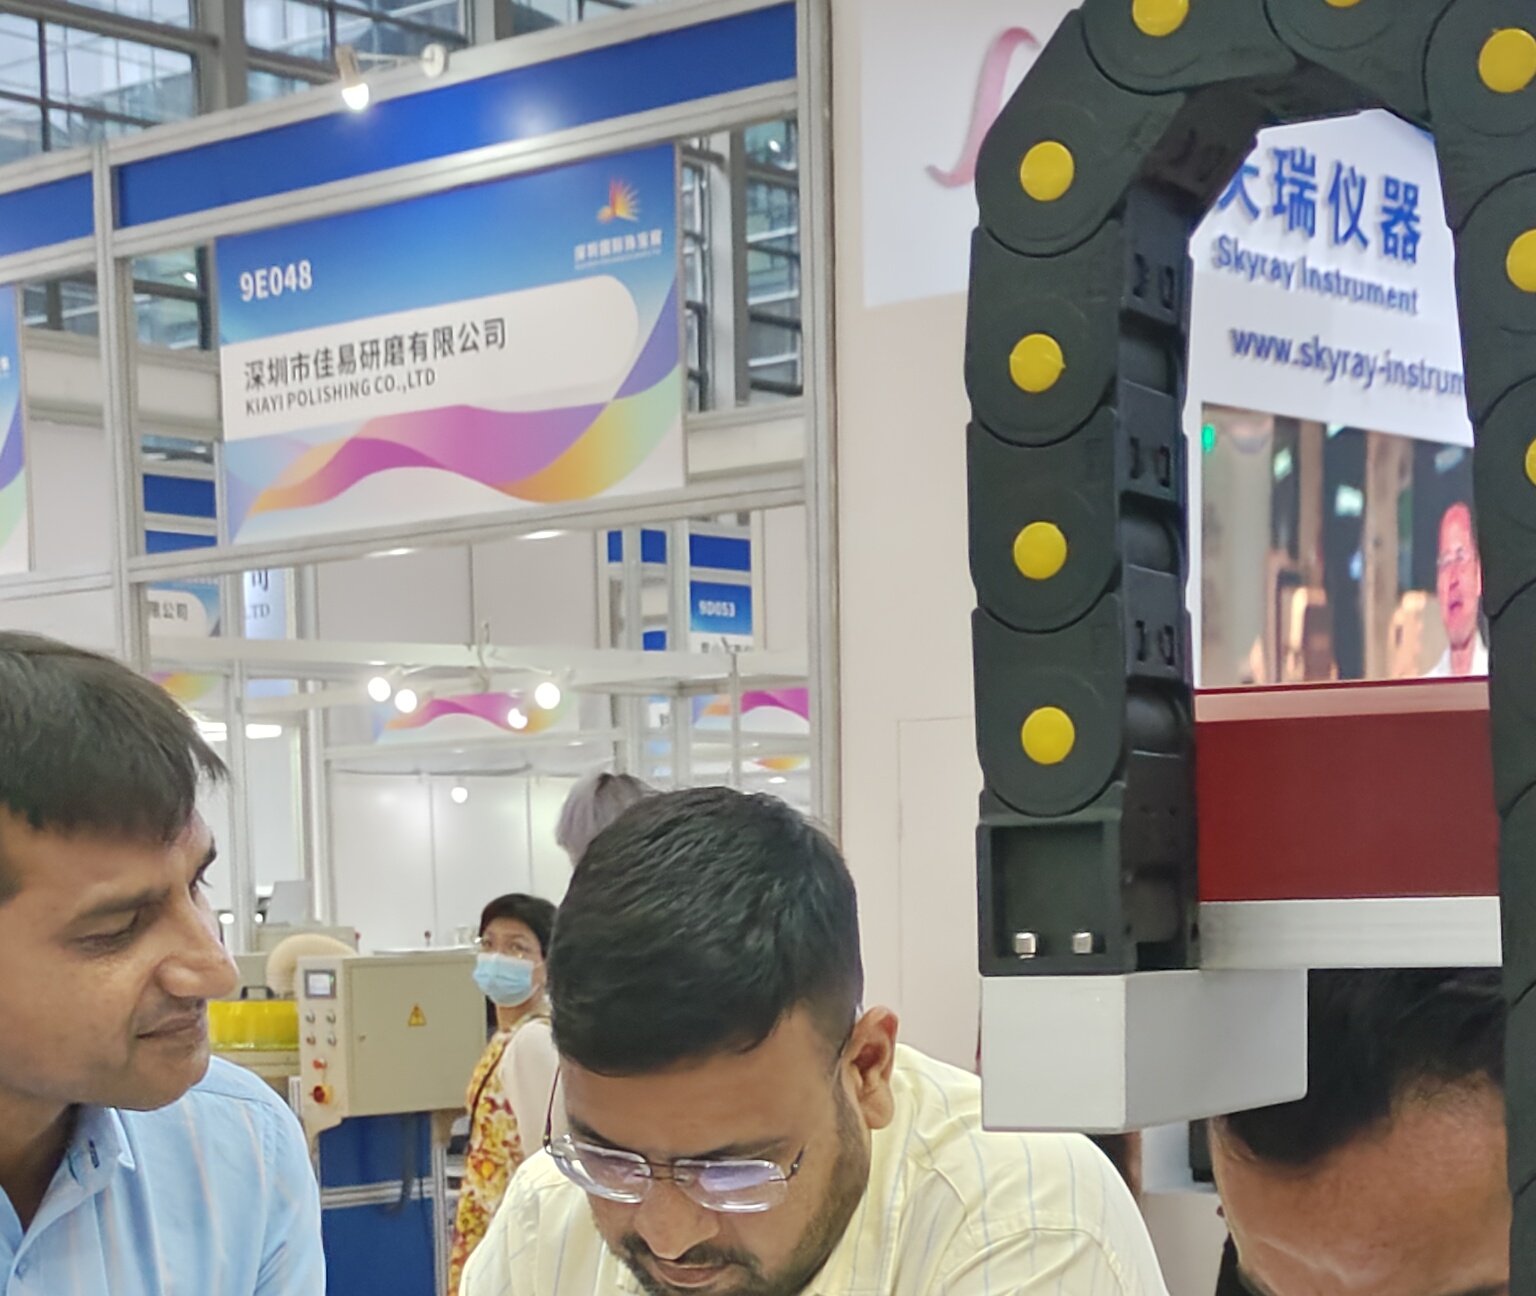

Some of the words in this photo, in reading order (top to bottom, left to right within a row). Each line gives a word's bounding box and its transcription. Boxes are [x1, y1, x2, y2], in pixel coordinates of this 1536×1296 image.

[239, 259, 312, 302] 9E048
[1215, 233, 1295, 291] Skyray
[1301, 256, 1419, 315] Instrument
[244, 317, 506, 392] 深圳市佳易研磨有限公司
[245, 394, 284, 417] KIAYI
[287, 377, 371, 410] POLISHING
